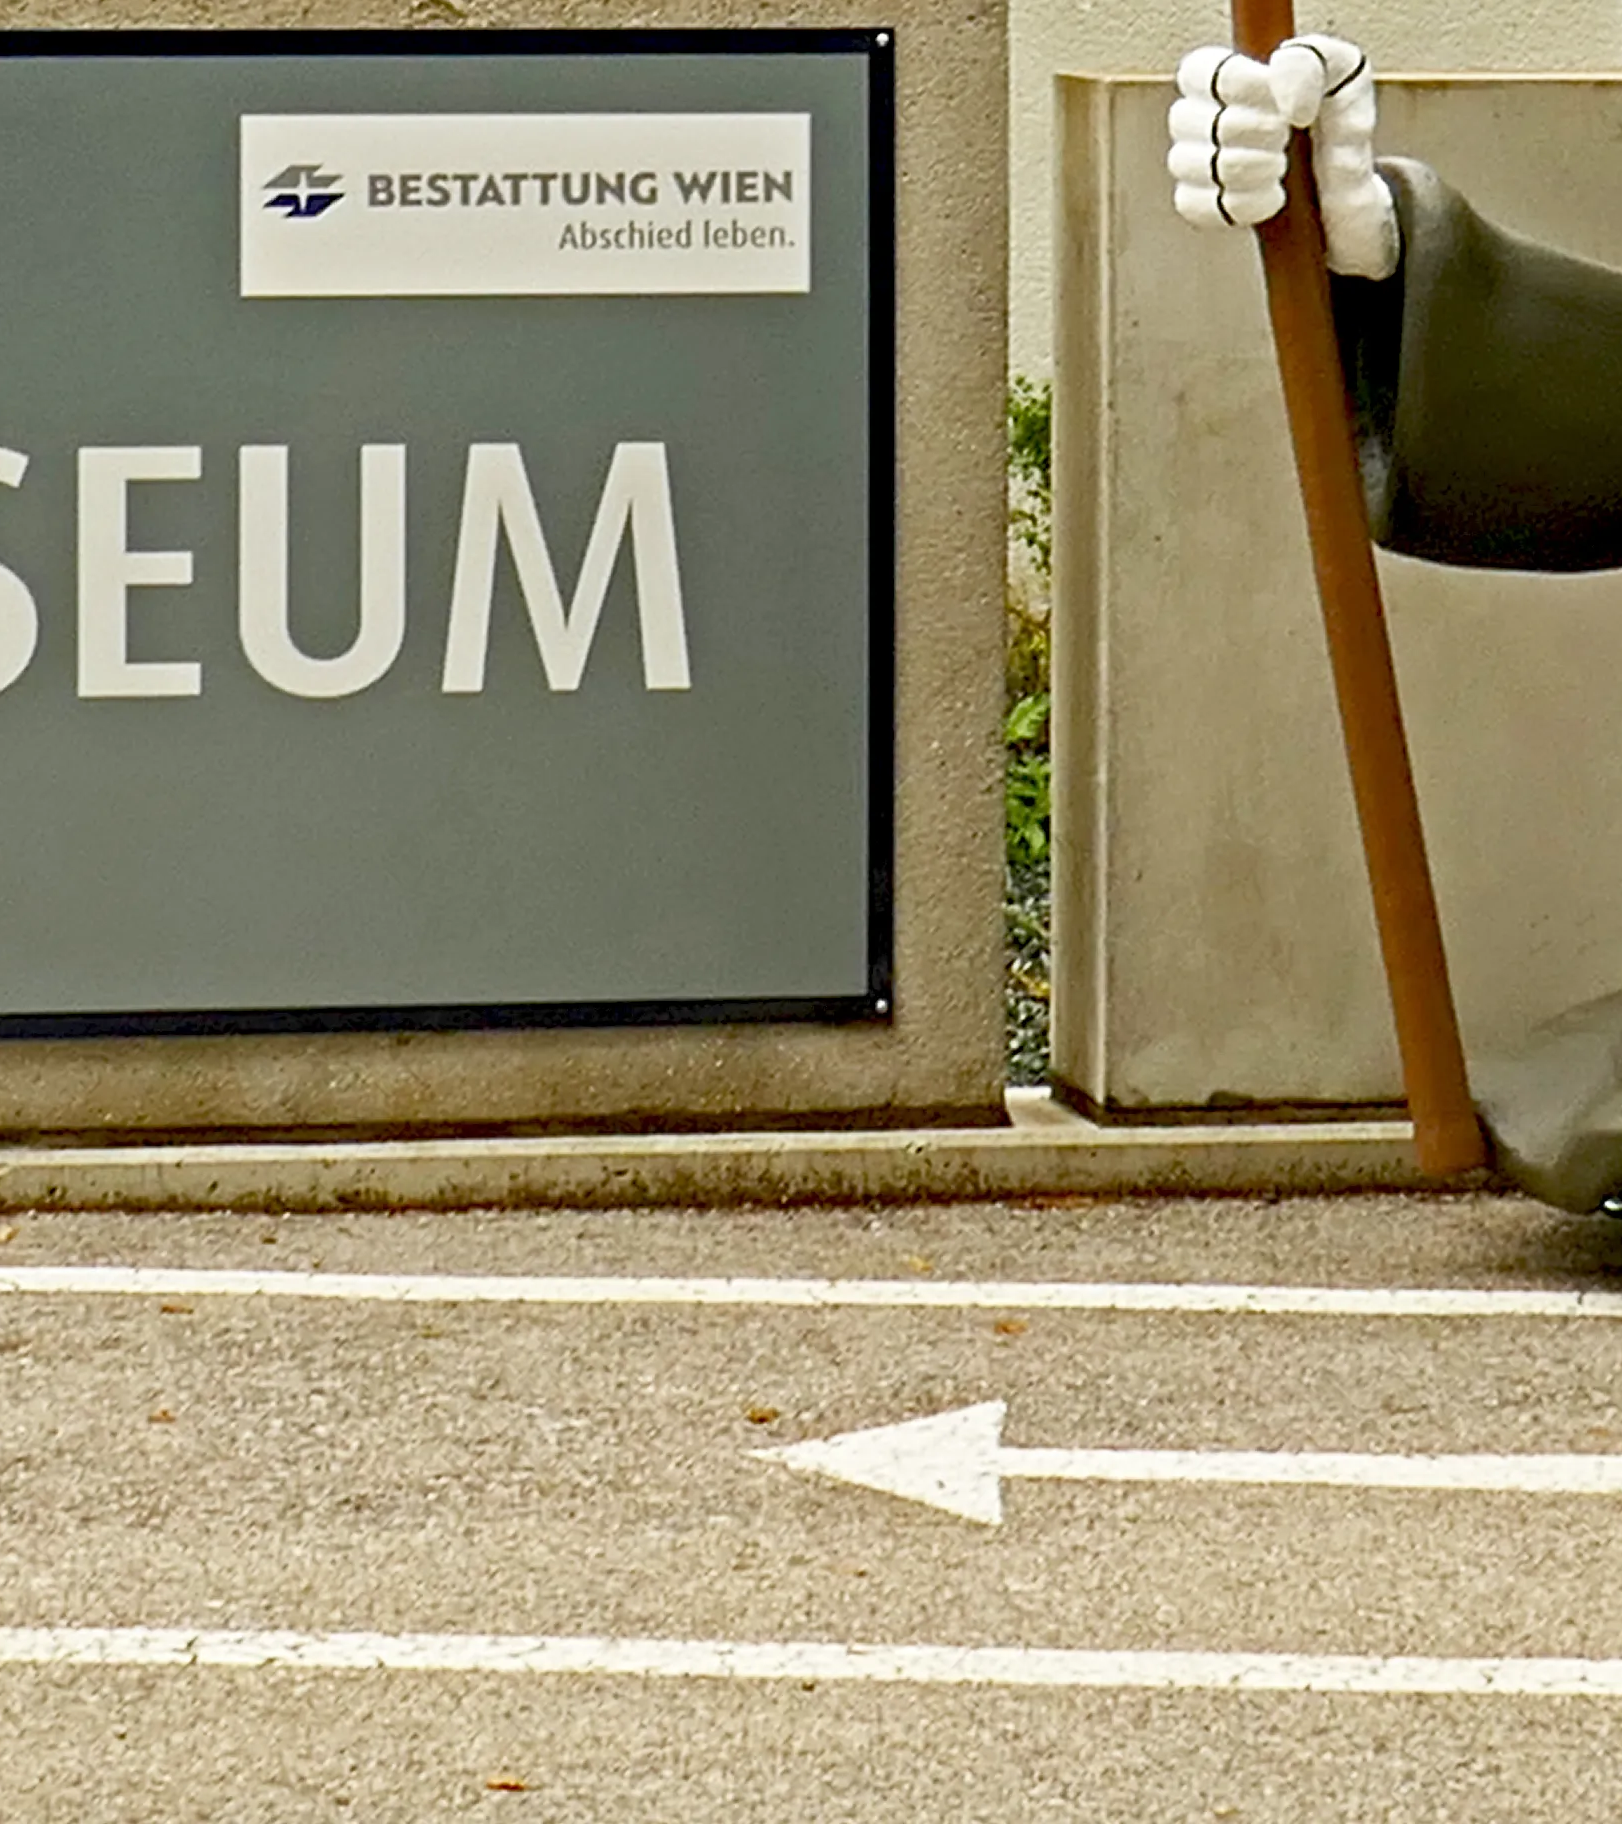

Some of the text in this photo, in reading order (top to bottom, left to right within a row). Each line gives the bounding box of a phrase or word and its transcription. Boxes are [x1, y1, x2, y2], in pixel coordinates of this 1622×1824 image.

[367, 170, 793, 208] BESTATTUNG WIEN
[558, 218, 795, 250] Abschied leben.
